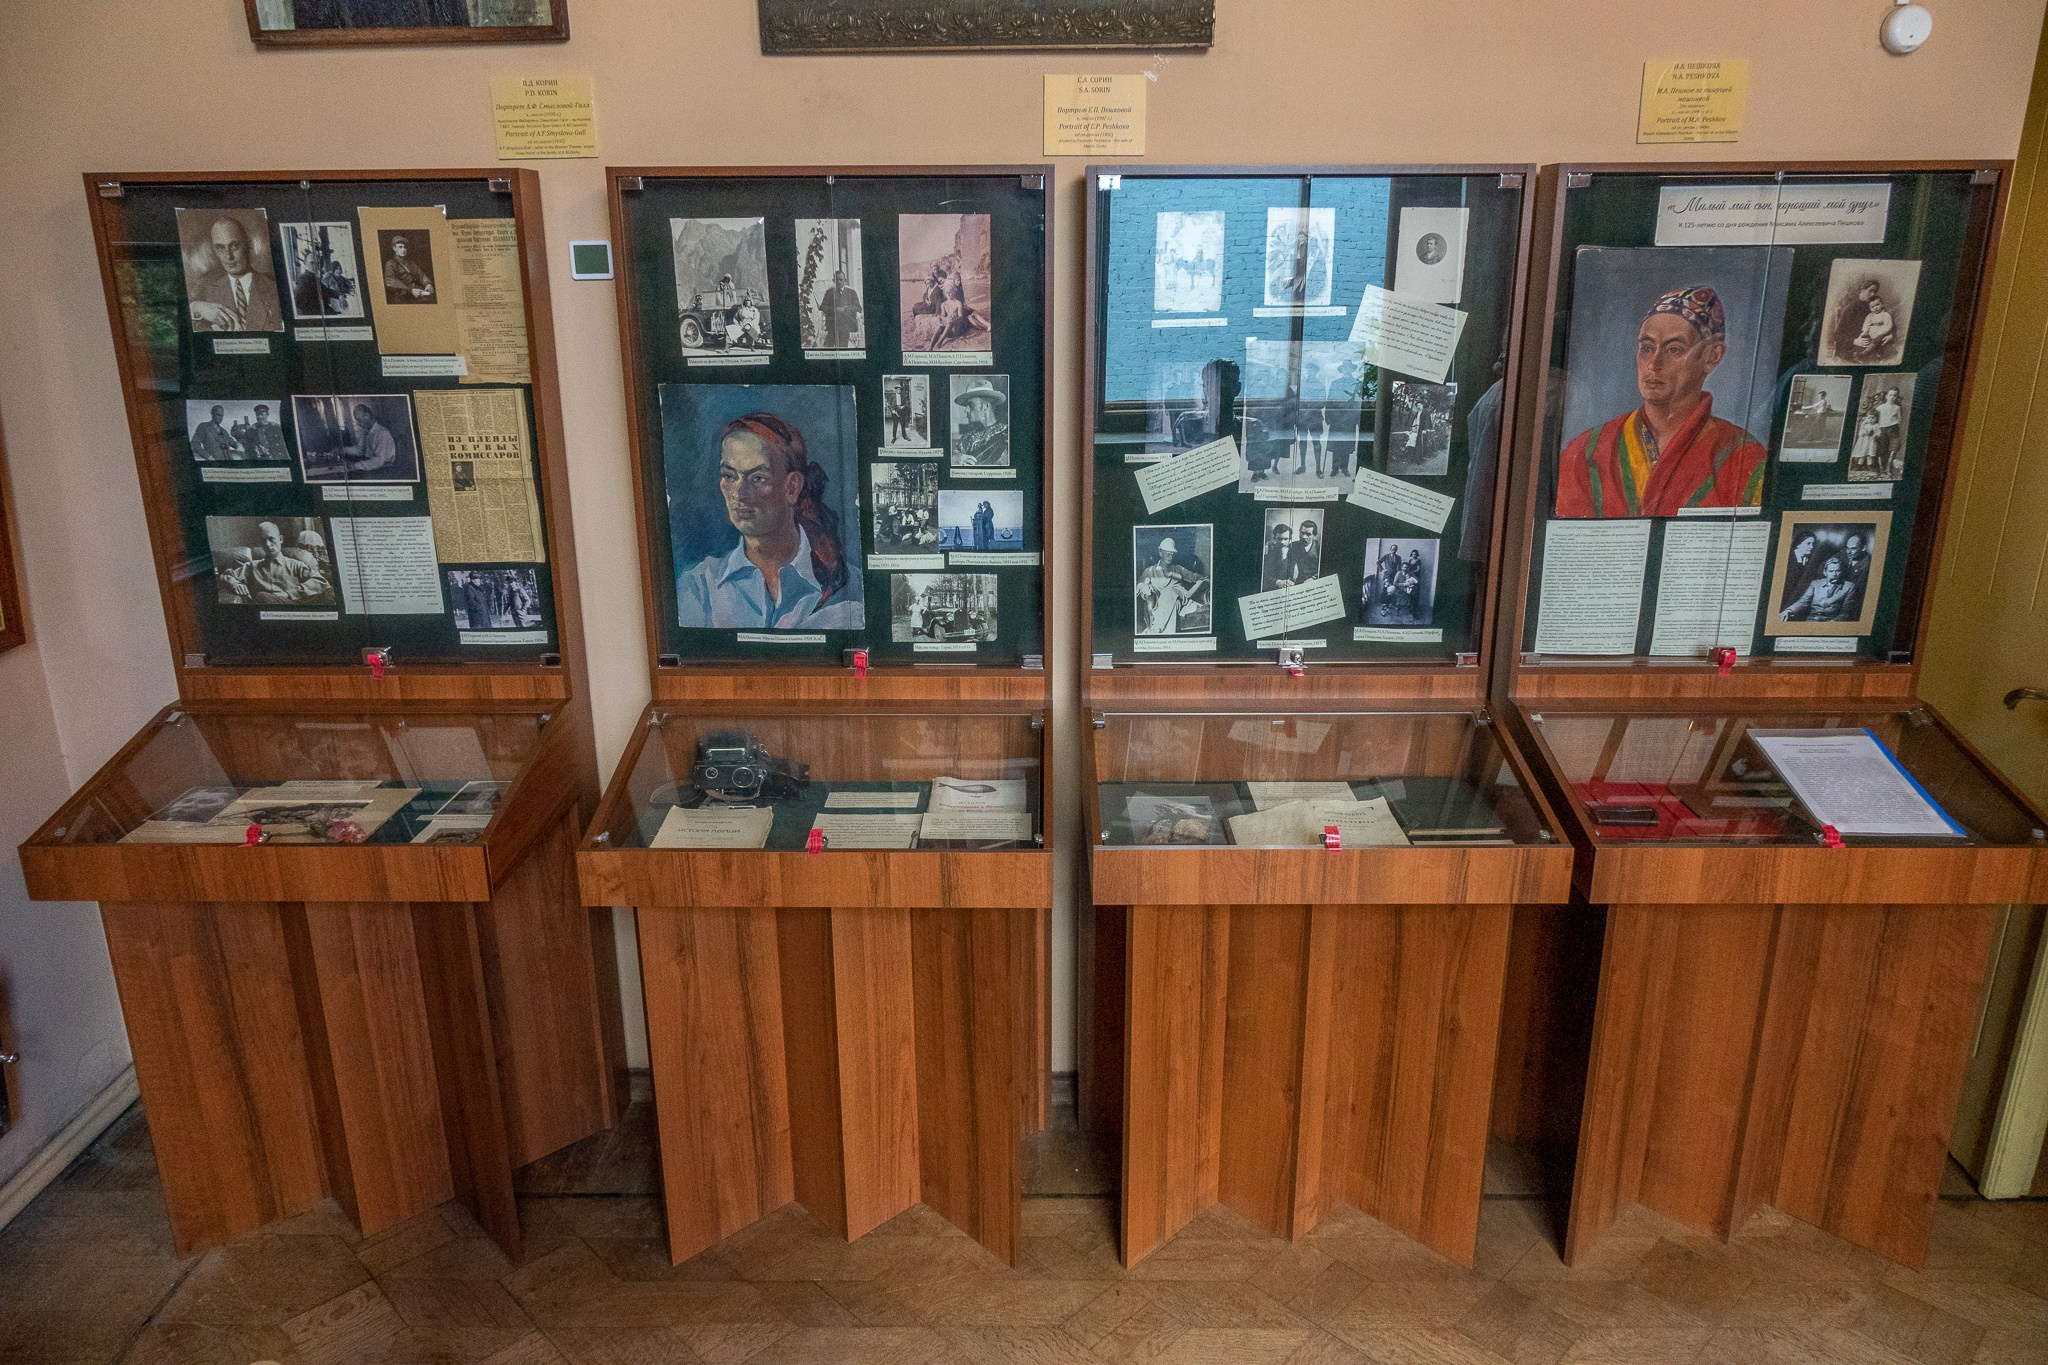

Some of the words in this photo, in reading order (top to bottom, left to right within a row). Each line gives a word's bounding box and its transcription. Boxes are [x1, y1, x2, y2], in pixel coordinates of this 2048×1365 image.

[496, 104, 525, 112] Портрет
[1057, 106, 1087, 114] Портрет
[1083, 123, 1090, 131] of
[1728, 200, 1752, 210] мой
[1754, 202, 1772, 211] сын,
[1777, 199, 1822, 214] хороший
[1822, 199, 1848, 209] мой
[468, 435, 518, 444] ПЛЕЯДЫ
